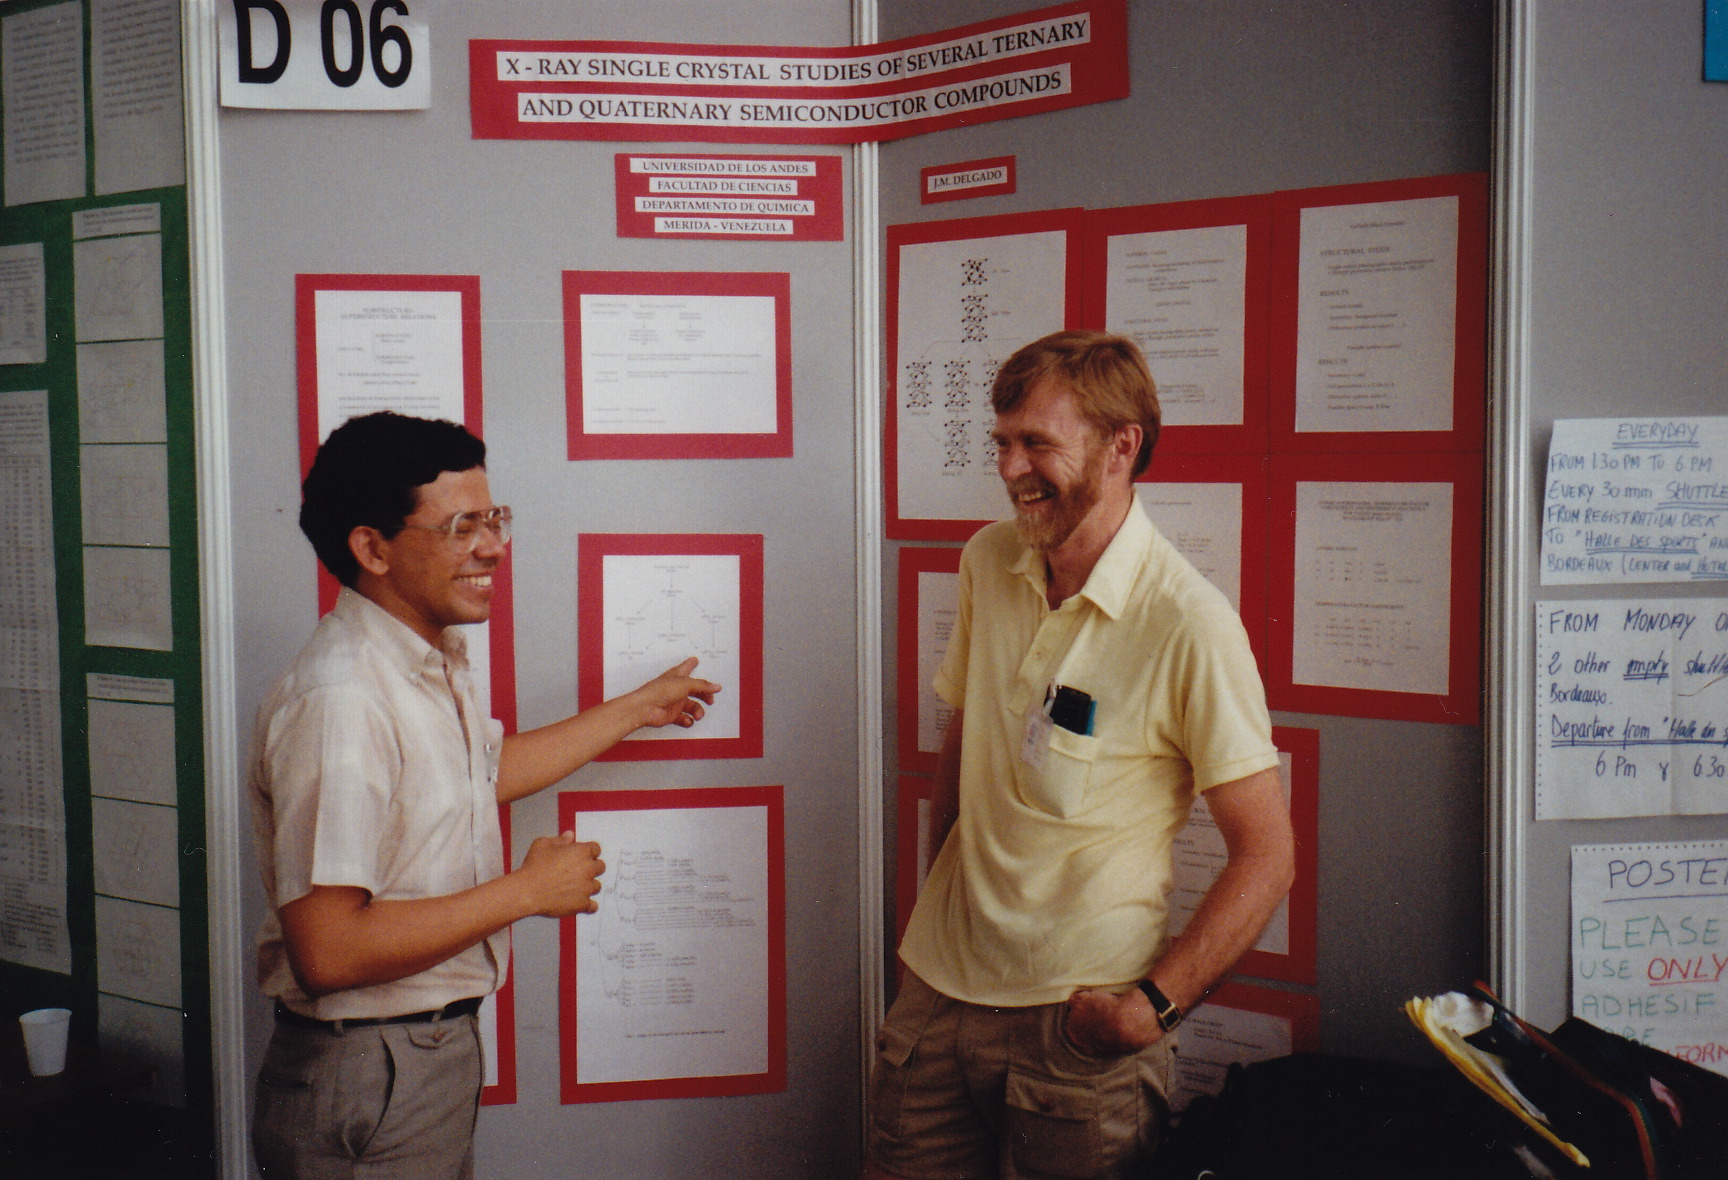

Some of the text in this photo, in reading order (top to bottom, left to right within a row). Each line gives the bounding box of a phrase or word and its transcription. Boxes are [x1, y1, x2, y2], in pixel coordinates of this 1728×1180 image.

[234, 0, 291, 83] D
[320, 0, 412, 88] 06
[588, 59, 670, 77] SINGLE
[676, 61, 770, 80] CRYSTAL
[780, 62, 872, 81] STUDIES
[877, 57, 902, 76] OF
[907, 40, 988, 72] SEVERAL
[992, 19, 1087, 53] TERNARY
[522, 71, 1061, 122] AND QUATERNARY SEMICONDUCTOR COMPOUNDS
[642, 162, 808, 173] UNIVERSIDAD DE LOS ANDES
[657, 181, 791, 192] FACULTAD DE CIENCIAS
[933, 169, 1002, 189] J.M. DELGADO
[642, 201, 809, 213] DEPARTAMENTO DE QUIMICA
[664, 220, 711, 229] MERIDA
[721, 222, 786, 231] VENEZUELA
[1616, 423, 1699, 443] EVERYDAY
[1549, 453, 1585, 472] FROM
[1624, 454, 1641, 469] PM
[1675, 454, 1683, 471] 6
[1691, 457, 1713, 472] PM
[1602, 481, 1619, 497] 30
[1666, 481, 1728, 499] SHUTTLE
[1682, 512, 1720, 528] DESK
[1548, 554, 1611, 572] BORDEAUX
[1549, 610, 1599, 634] FROM
[1624, 608, 1696, 640] MONDAY
[1549, 652, 1561, 674] 2
[1574, 652, 1610, 674] other
[1623, 718, 1650, 749] from
[1595, 749, 1606, 777] 6
[1608, 858, 1728, 889] POSTE
[1580, 915, 1720, 950] PLEASE
[1580, 954, 1728, 981] USE ONLY
